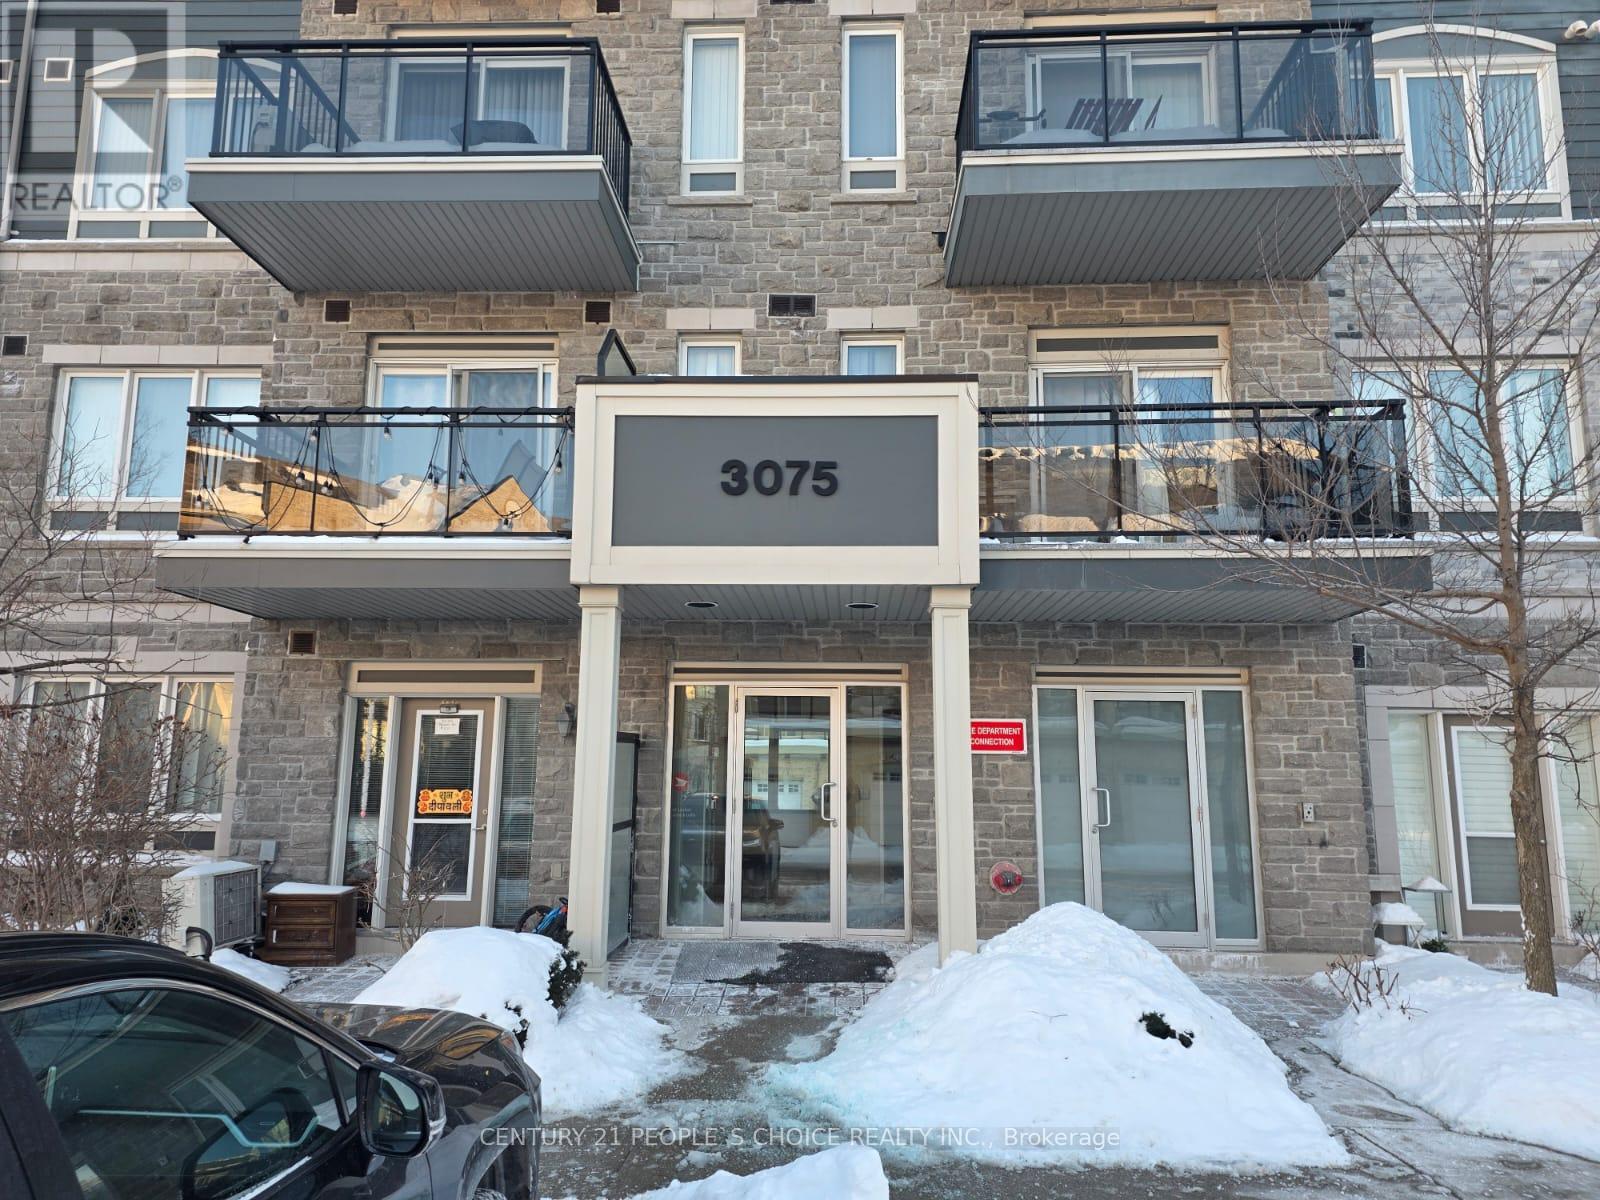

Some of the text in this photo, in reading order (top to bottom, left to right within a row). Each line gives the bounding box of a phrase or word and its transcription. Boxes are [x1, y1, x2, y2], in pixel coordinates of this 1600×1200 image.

[720, 459, 839, 497] 3075
[977, 727, 1021, 735] DEPARTMENT
[970, 738, 1014, 746] CONNECTION
[428, 799, 462, 811] दीपावली
